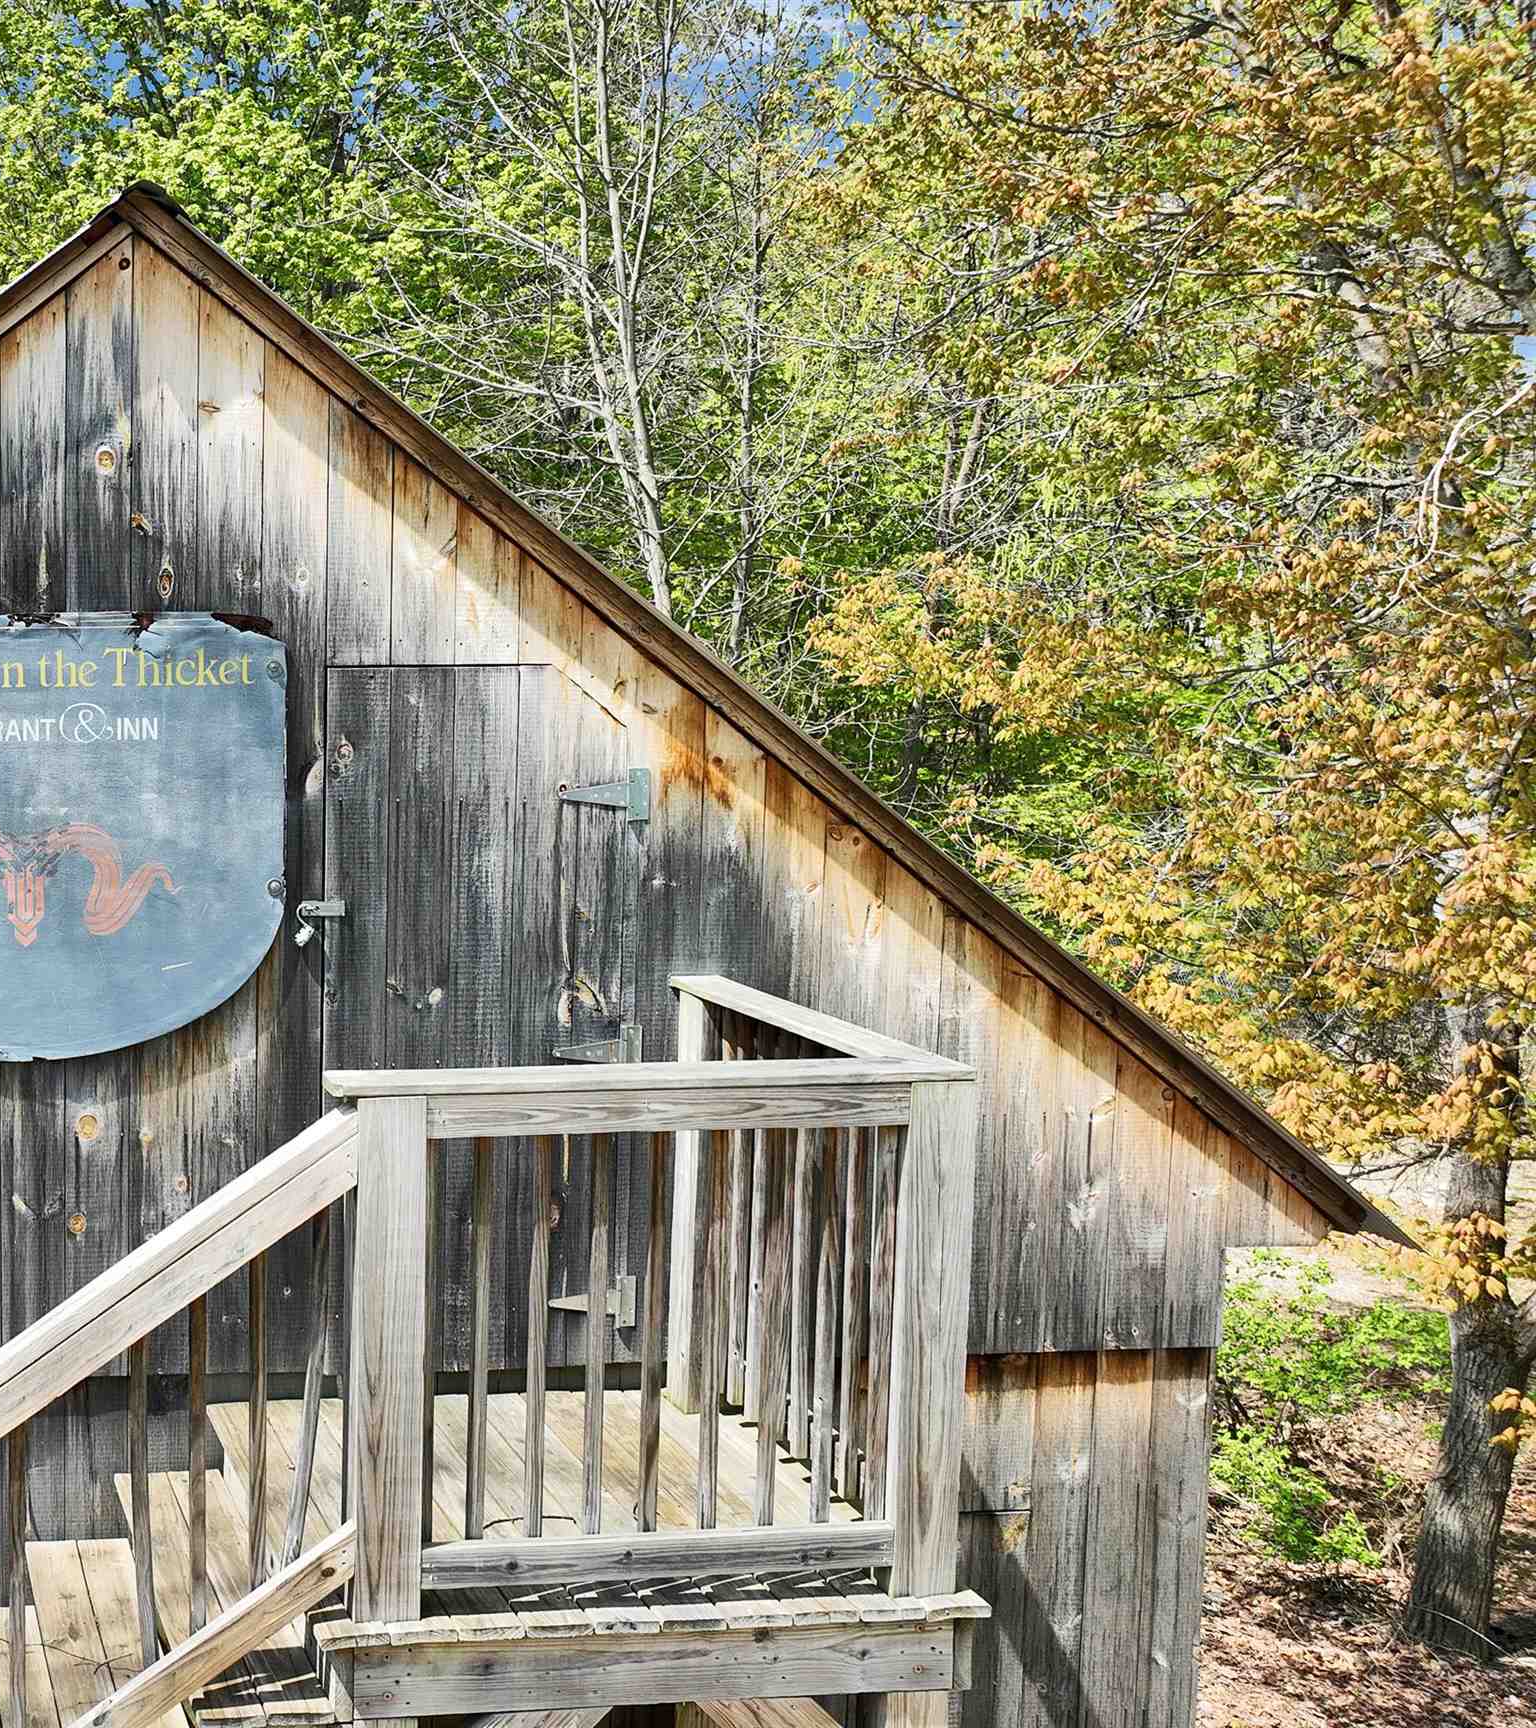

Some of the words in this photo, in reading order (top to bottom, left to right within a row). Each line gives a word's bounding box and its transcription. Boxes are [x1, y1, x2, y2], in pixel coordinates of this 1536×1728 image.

[38, 650, 97, 689] the
[103, 646, 257, 689] Thicket
[58, 702, 114, 744] &
[116, 716, 159, 742] INN
